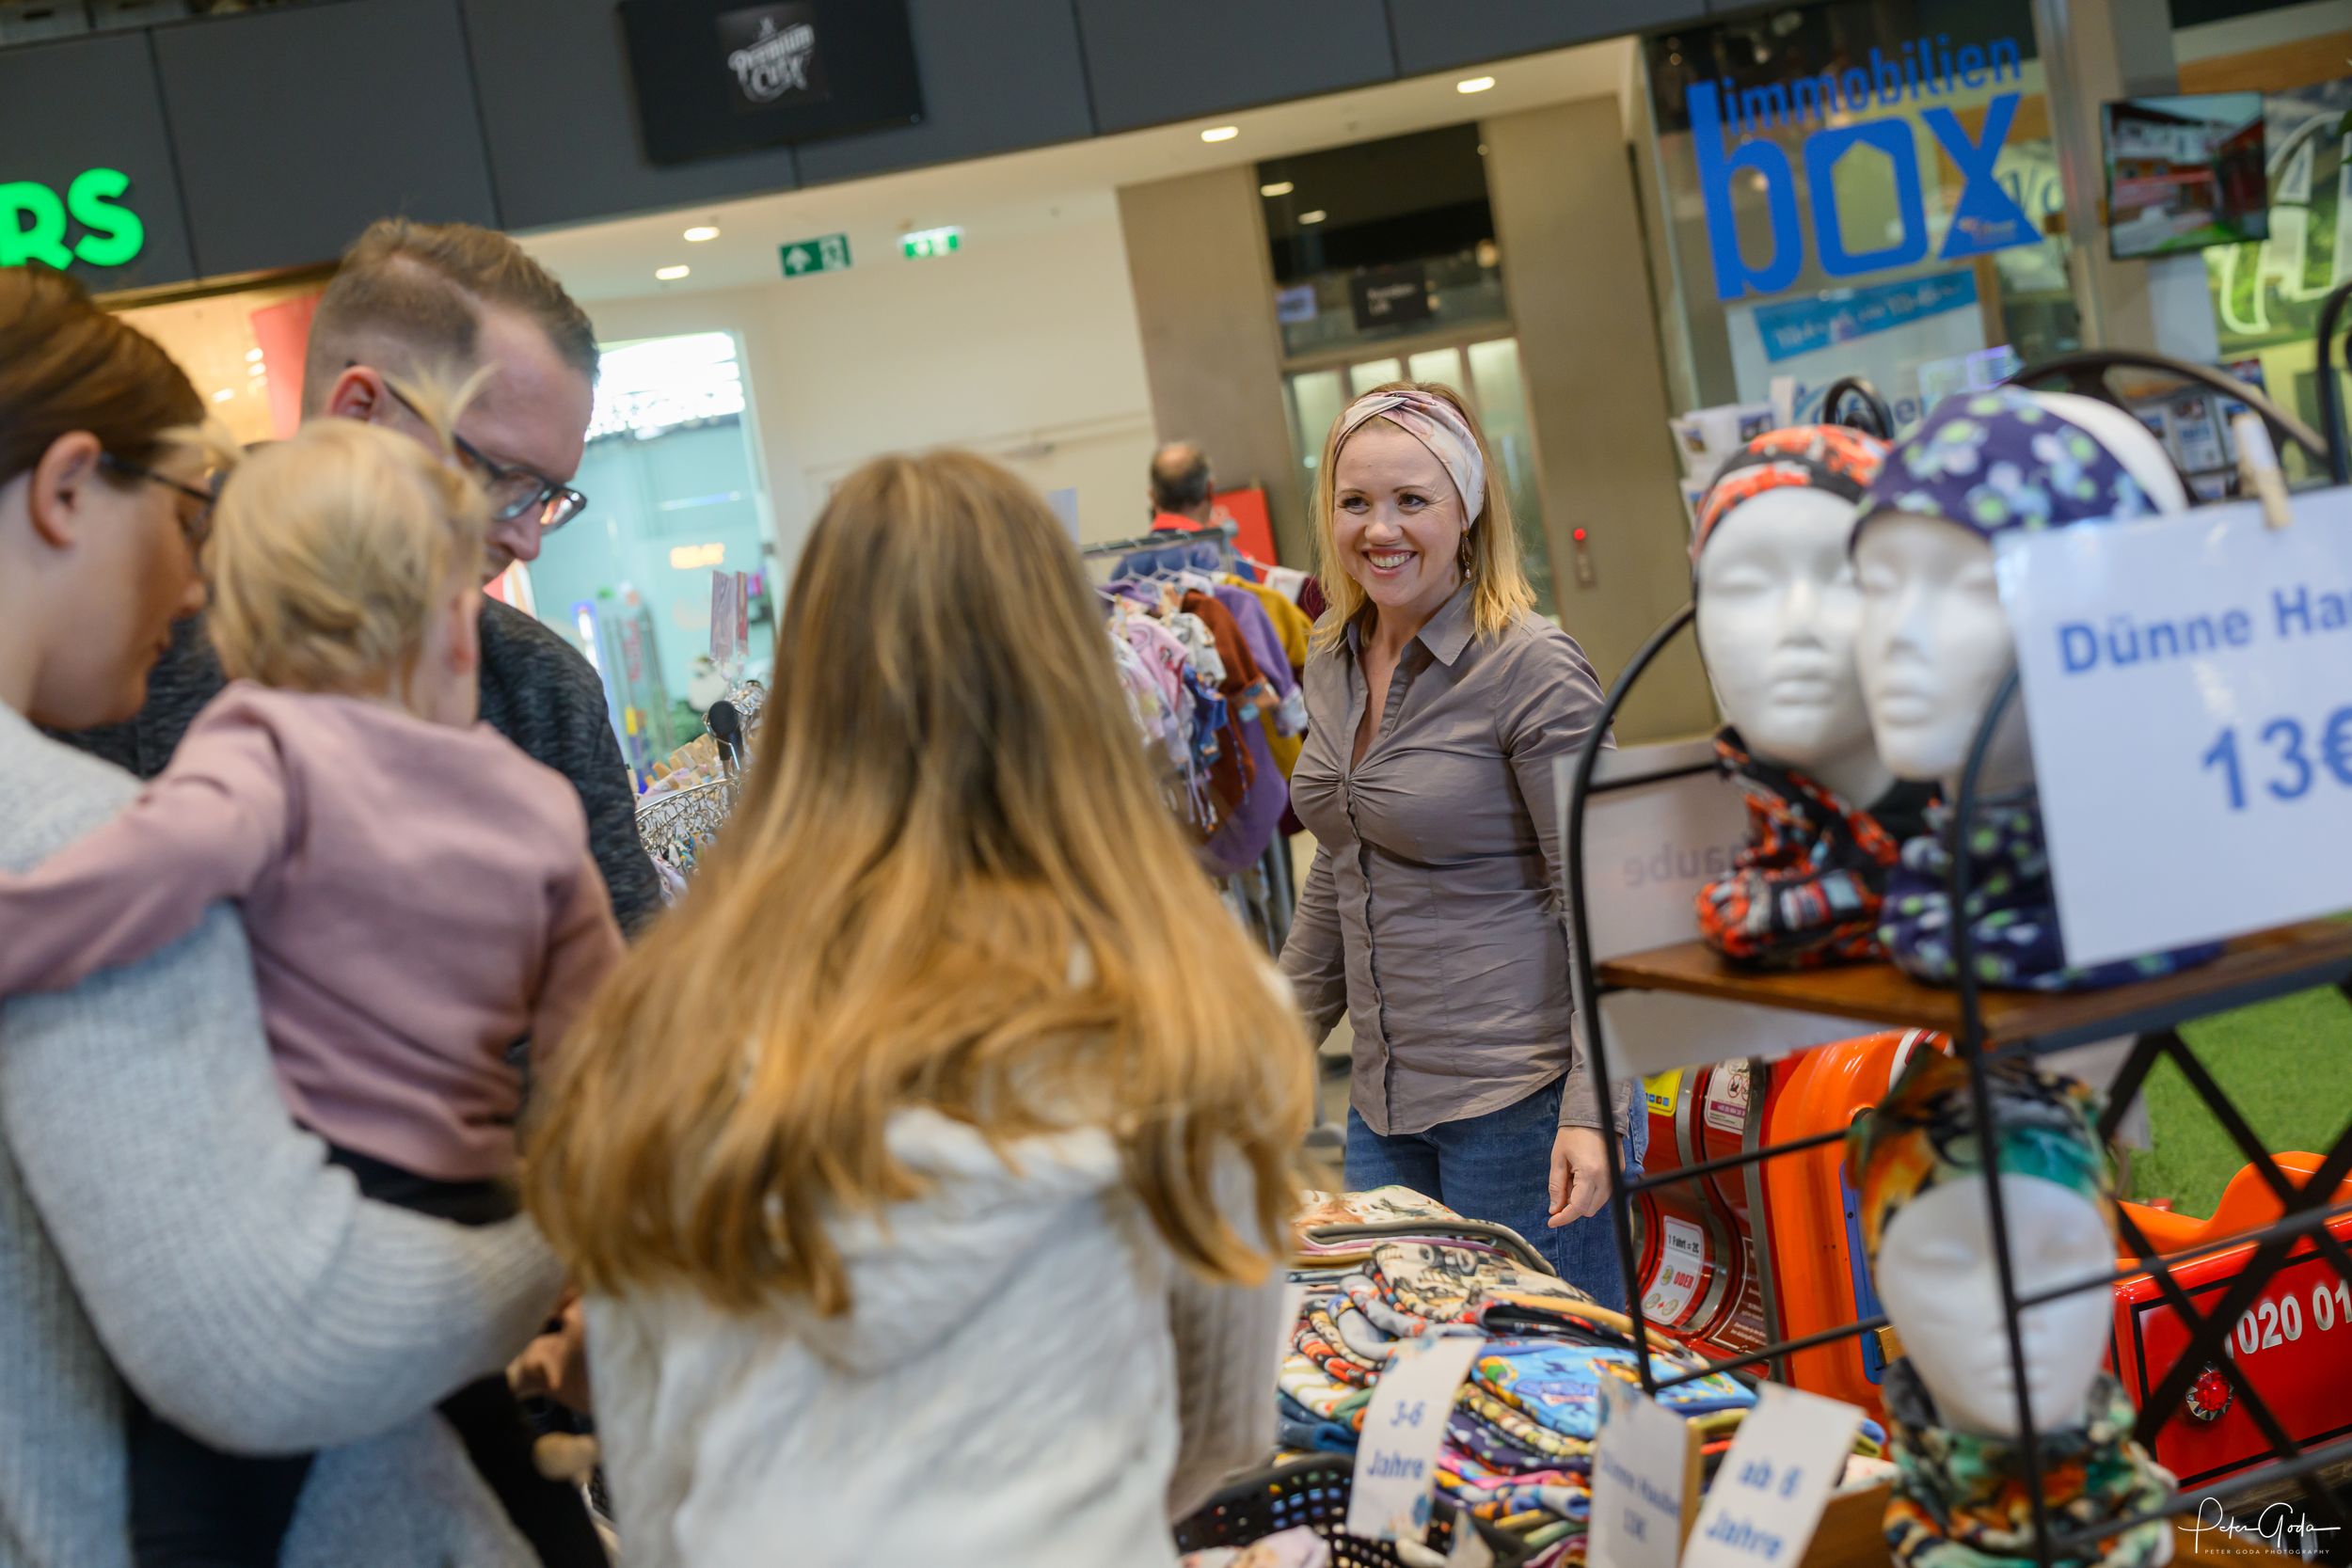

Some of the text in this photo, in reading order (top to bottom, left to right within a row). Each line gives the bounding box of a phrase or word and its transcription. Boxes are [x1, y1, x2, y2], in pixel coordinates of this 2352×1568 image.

[1723, 34, 2022, 135] immobilien
[1686, 80, 2043, 301] box
[2058, 583, 2352, 674] Dünne Ha
[2202, 704, 2352, 811] 13€
[1673, 1271, 1694, 1290] ODER
[1367, 1449, 1425, 1480] Jahre
[1739, 1459, 1772, 1490] ab
[1705, 1508, 1785, 1561] Jahre
